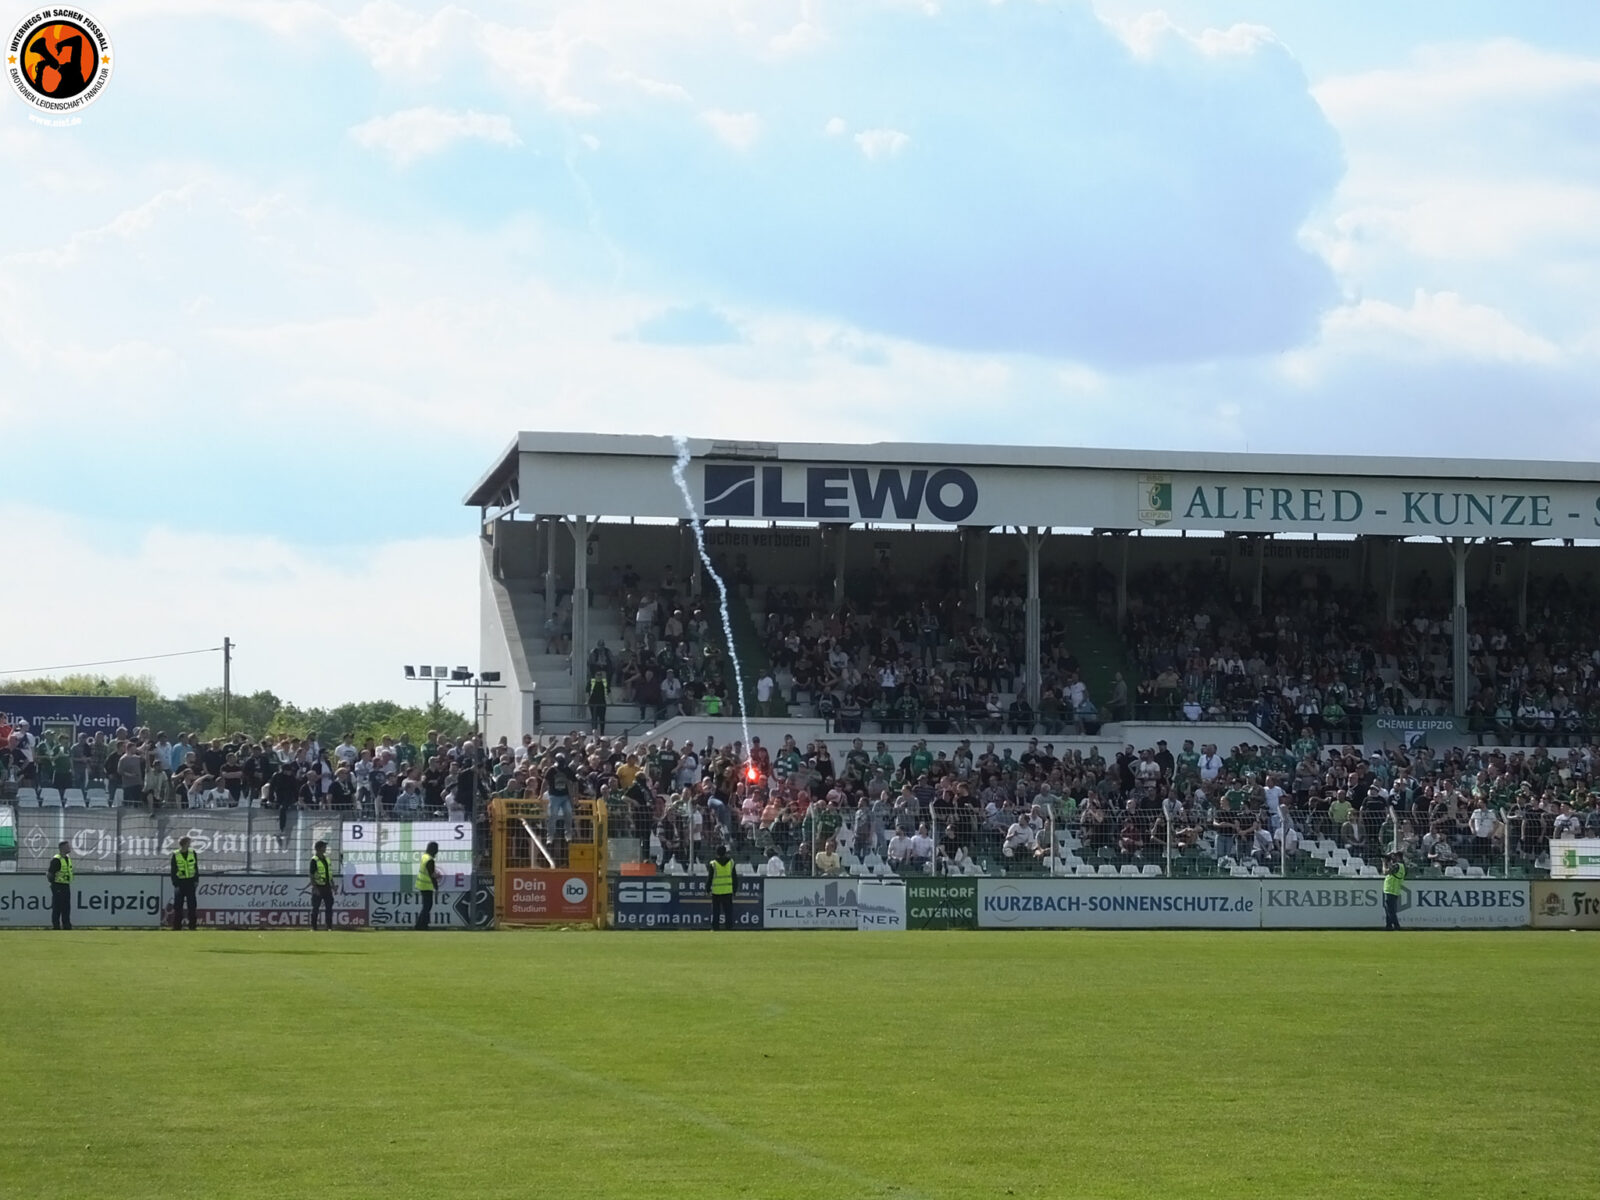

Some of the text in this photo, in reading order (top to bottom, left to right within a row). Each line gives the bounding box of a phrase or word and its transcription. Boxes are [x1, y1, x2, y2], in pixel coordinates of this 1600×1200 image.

[762, 466, 978, 522] LEWO
[1183, 484, 1363, 523] ALFRED
[1402, 491, 1553, 527] KUNZE
[1140, 511, 1170, 519] LEIPZIG
[1376, 719, 1454, 730] CHEMIE LEIPZIG
[351, 824, 465, 840] B S
[71, 828, 175, 860] Chemie
[198, 881, 289, 897] astroservice
[351, 873, 366, 889] G
[454, 873, 465, 888] E
[513, 878, 546, 891] Dein
[513, 892, 546, 903] duales
[566, 884, 584, 895] iba
[909, 887, 975, 898] HEINDORF
[77, 890, 161, 914] Leipzig
[247, 898, 268, 908] der
[984, 896, 1254, 913] KURZBACH-SONNENSCHUTZ.de
[1267, 889, 1378, 907] KRABBES
[1416, 890, 1525, 907] KRABBES
[512, 904, 547, 914] Studium
[910, 907, 973, 919] CATERING
